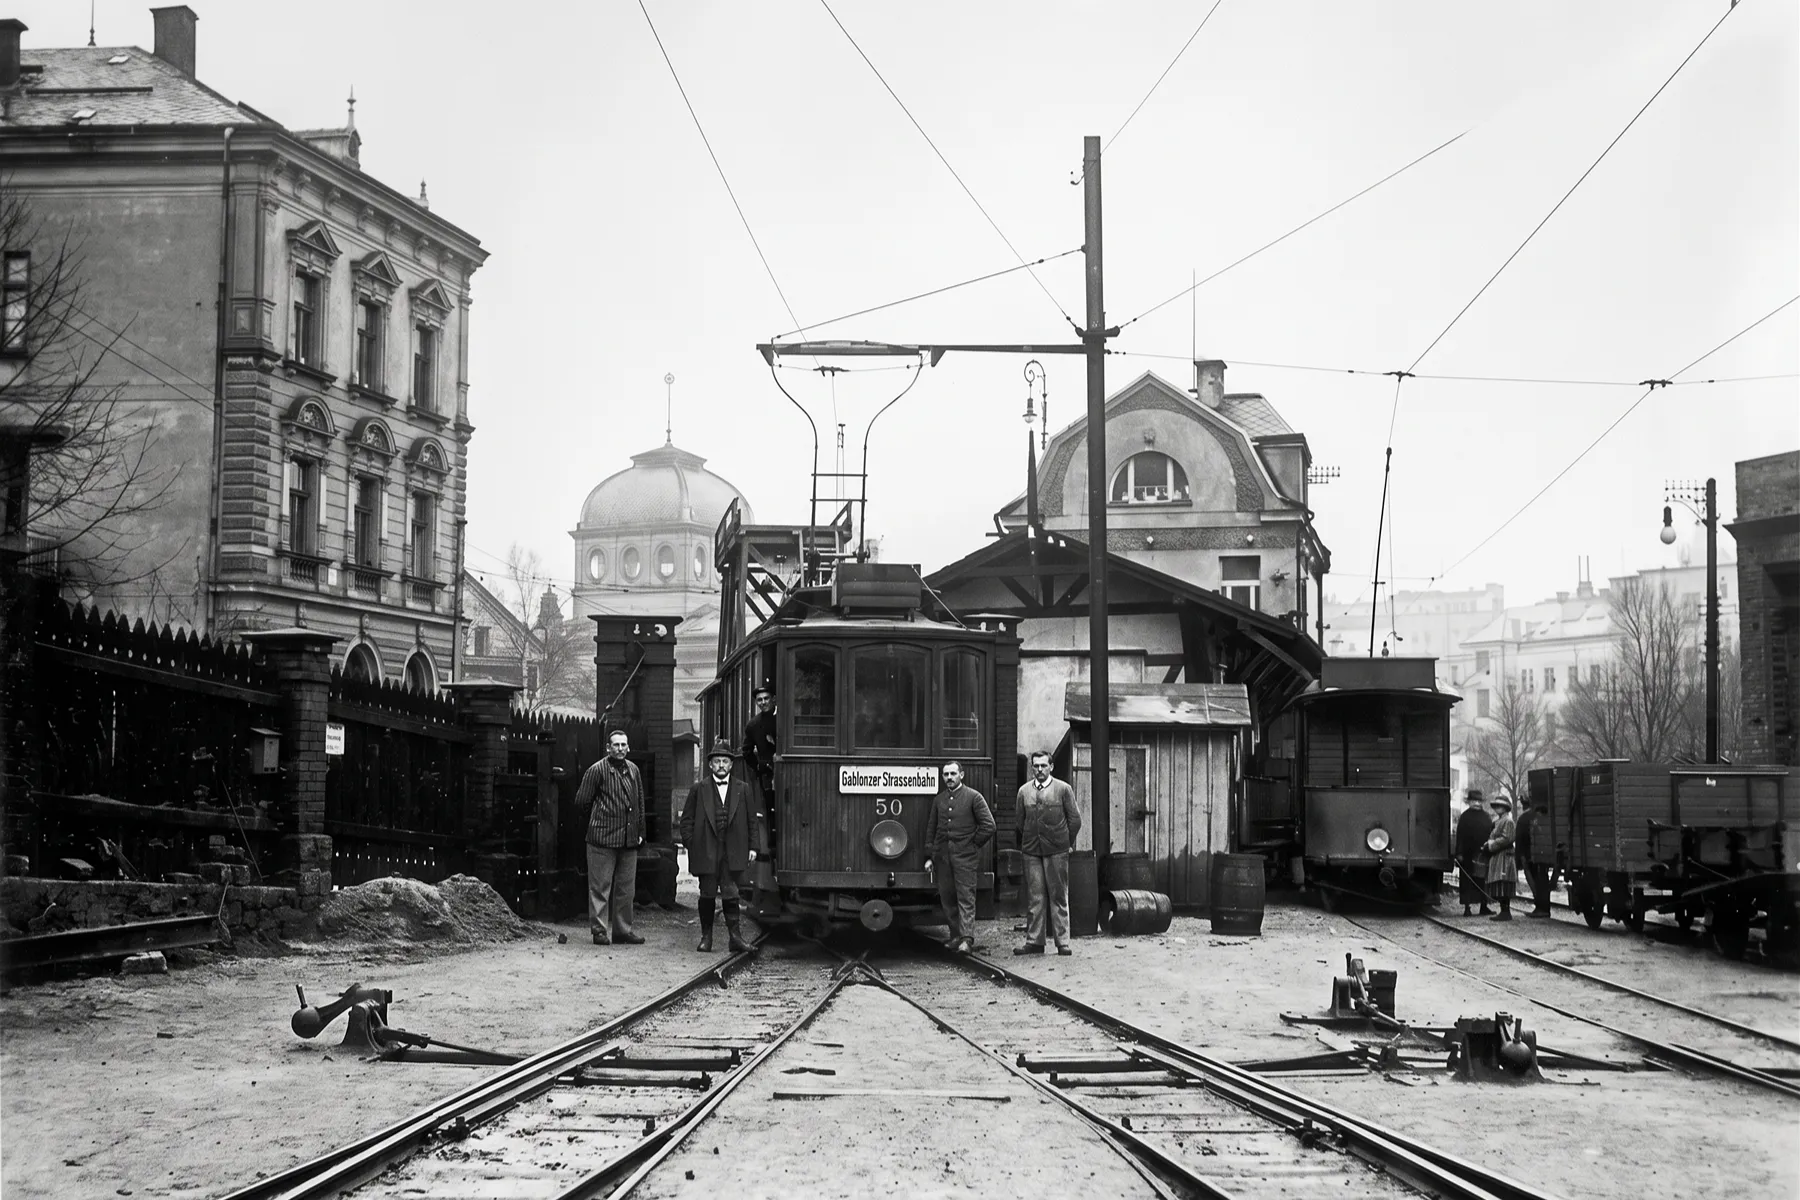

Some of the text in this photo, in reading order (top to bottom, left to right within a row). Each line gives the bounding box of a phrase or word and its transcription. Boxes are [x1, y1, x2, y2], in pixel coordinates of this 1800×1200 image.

[842, 771, 936, 787] Gablonzer Strassenbahn
[876, 798, 903, 816] 50
